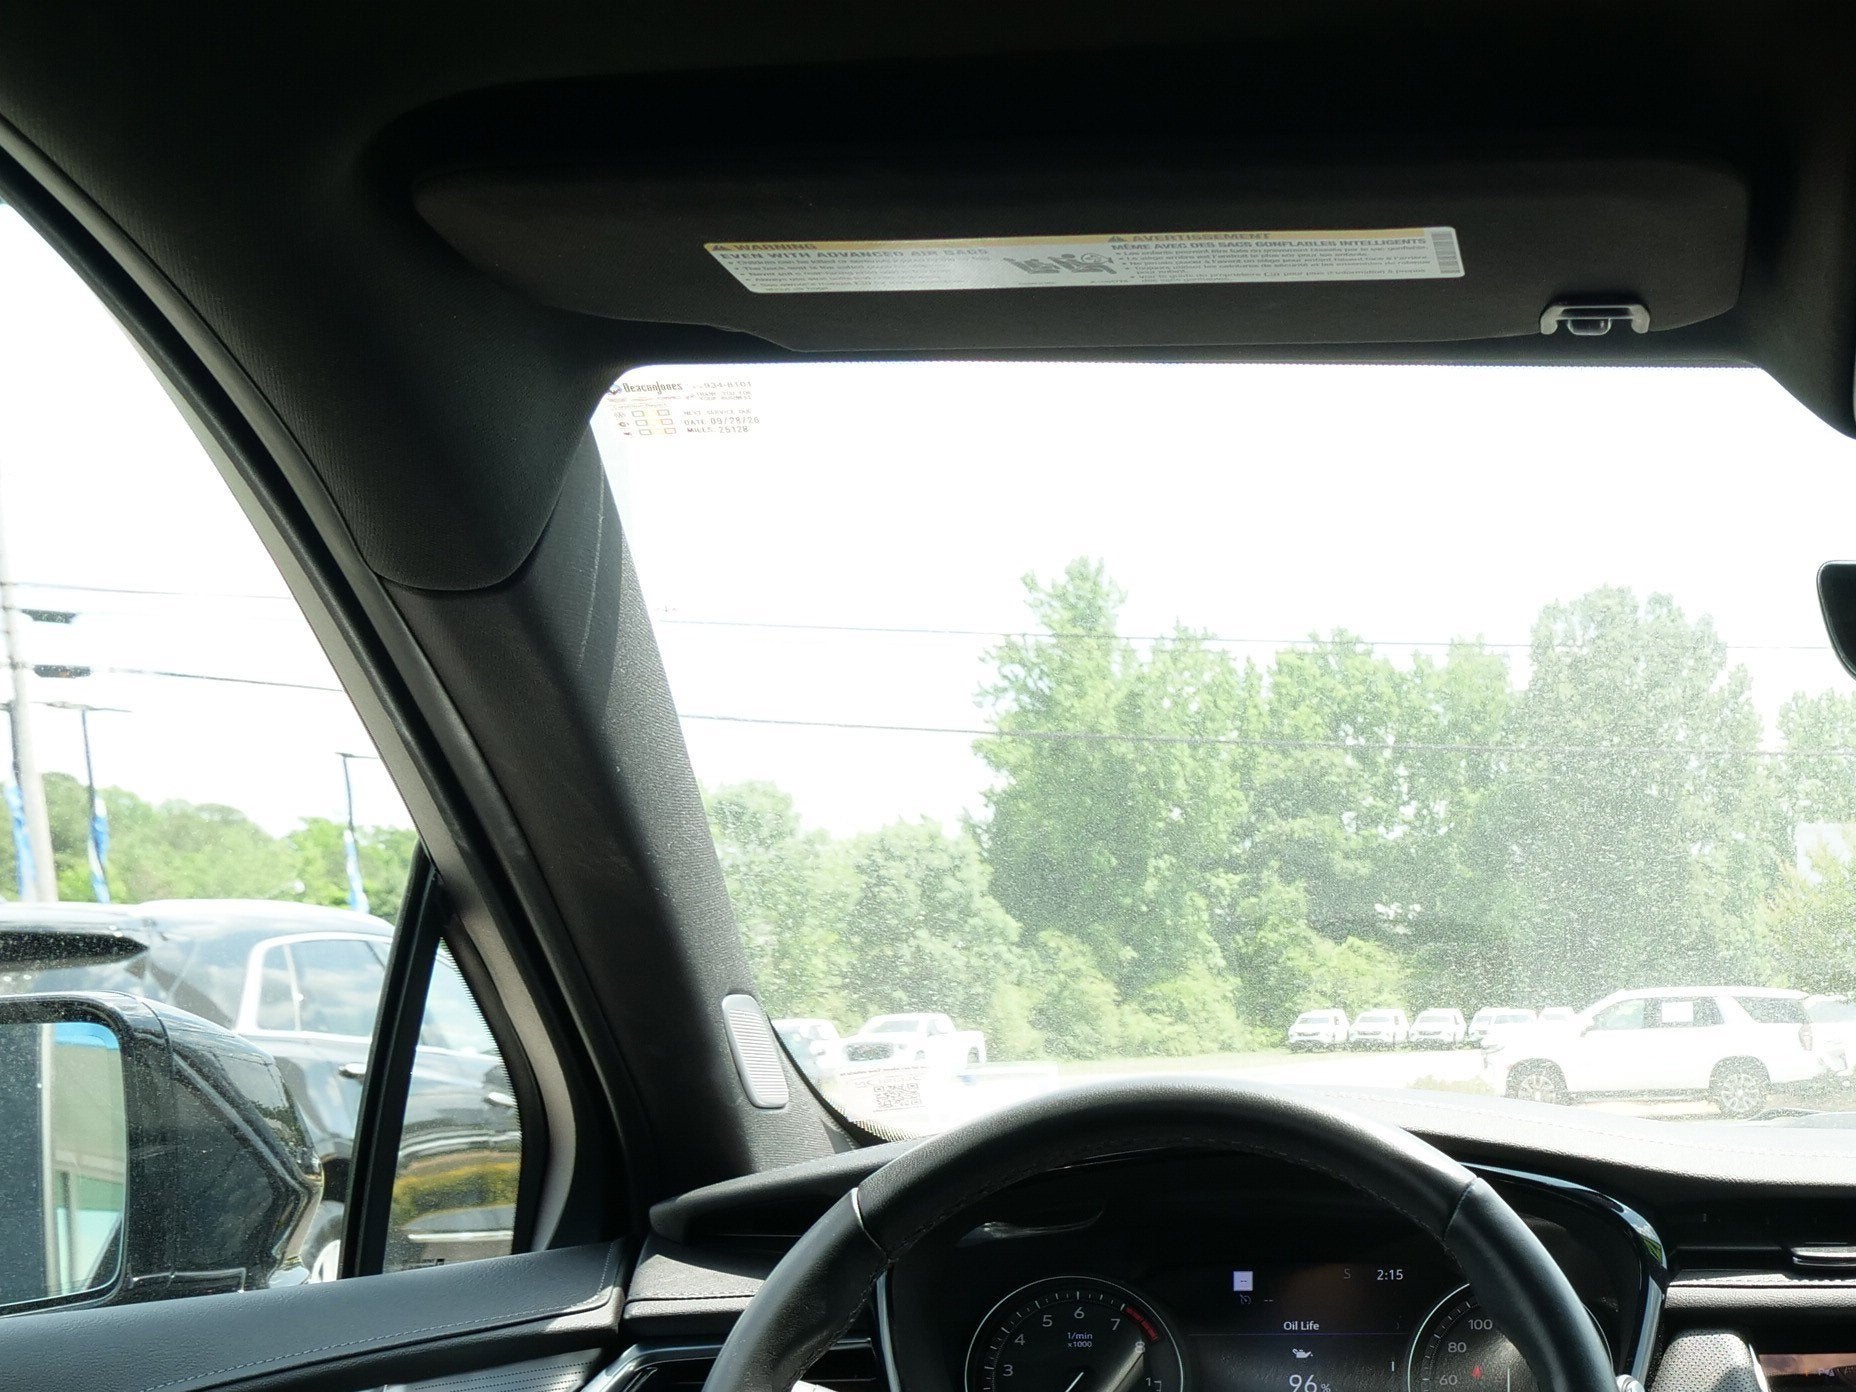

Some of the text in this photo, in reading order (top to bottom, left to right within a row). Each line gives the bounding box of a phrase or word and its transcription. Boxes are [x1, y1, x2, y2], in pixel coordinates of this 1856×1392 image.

[1133, 233, 1270, 242] AVERTISSEMENT
[1190, 241, 1215, 249] DES
[1340, 238, 1427, 246] INTELLIGENTS
[733, 243, 818, 251] WARNING
[720, 252, 764, 260] EVEN
[767, 251, 812, 259] WITH
[817, 250, 904, 258] ADVANCED
[1376, 1269, 1404, 1281] 2:15
[1073, 1307, 1085, 1319] 6
[1042, 1315, 1053, 1327] 5
[1110, 1318, 1121, 1331] 7
[1283, 1321, 1320, 1331] Oil Life
[1468, 1319, 1493, 1330] 100
[1014, 1334, 1026, 1346] 4
[1134, 1341, 1145, 1353] 8
[1447, 1342, 1467, 1353] 80
[1002, 1364, 1014, 1377] 3
[1439, 1374, 1458, 1386] 60
